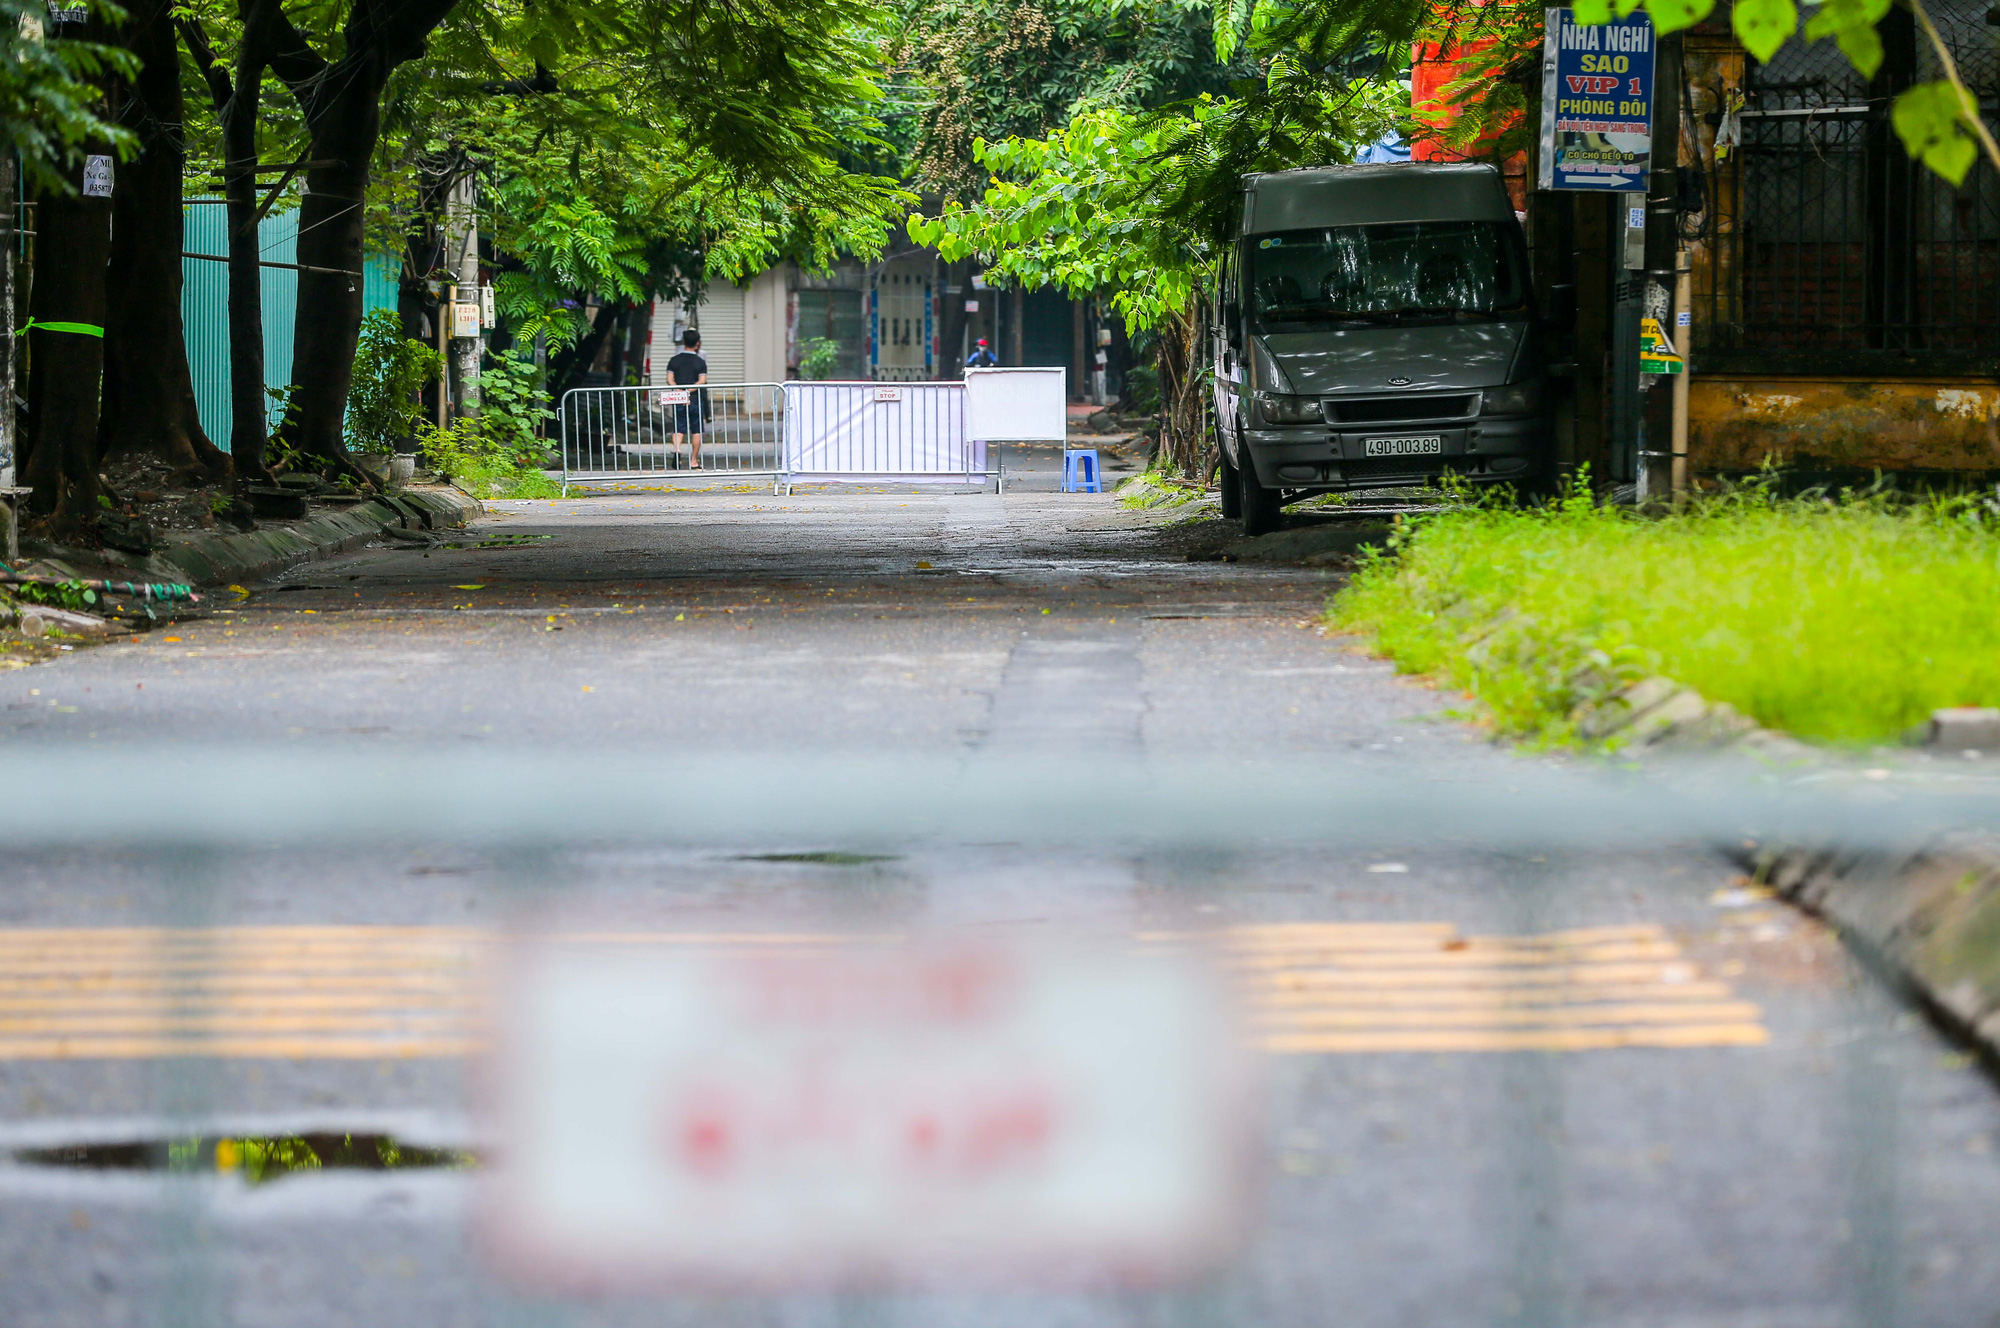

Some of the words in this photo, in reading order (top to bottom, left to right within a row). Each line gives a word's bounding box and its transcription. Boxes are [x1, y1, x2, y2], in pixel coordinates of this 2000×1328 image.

[1605, 20, 1650, 52] NGHỈ
[1580, 54, 1629, 73] SAO
[1566, 75, 1619, 94] VIP
[1629, 77, 1642, 95] 1
[1559, 96, 1615, 115] PHÒNG
[1619, 98, 1647, 116] ĐÔI
[1610, 121, 1626, 134] SANG
[1623, 151, 1634, 160] TÔ
[86, 171, 97, 179] Xe
[1368, 438, 1439, 455] 49D-003.89
